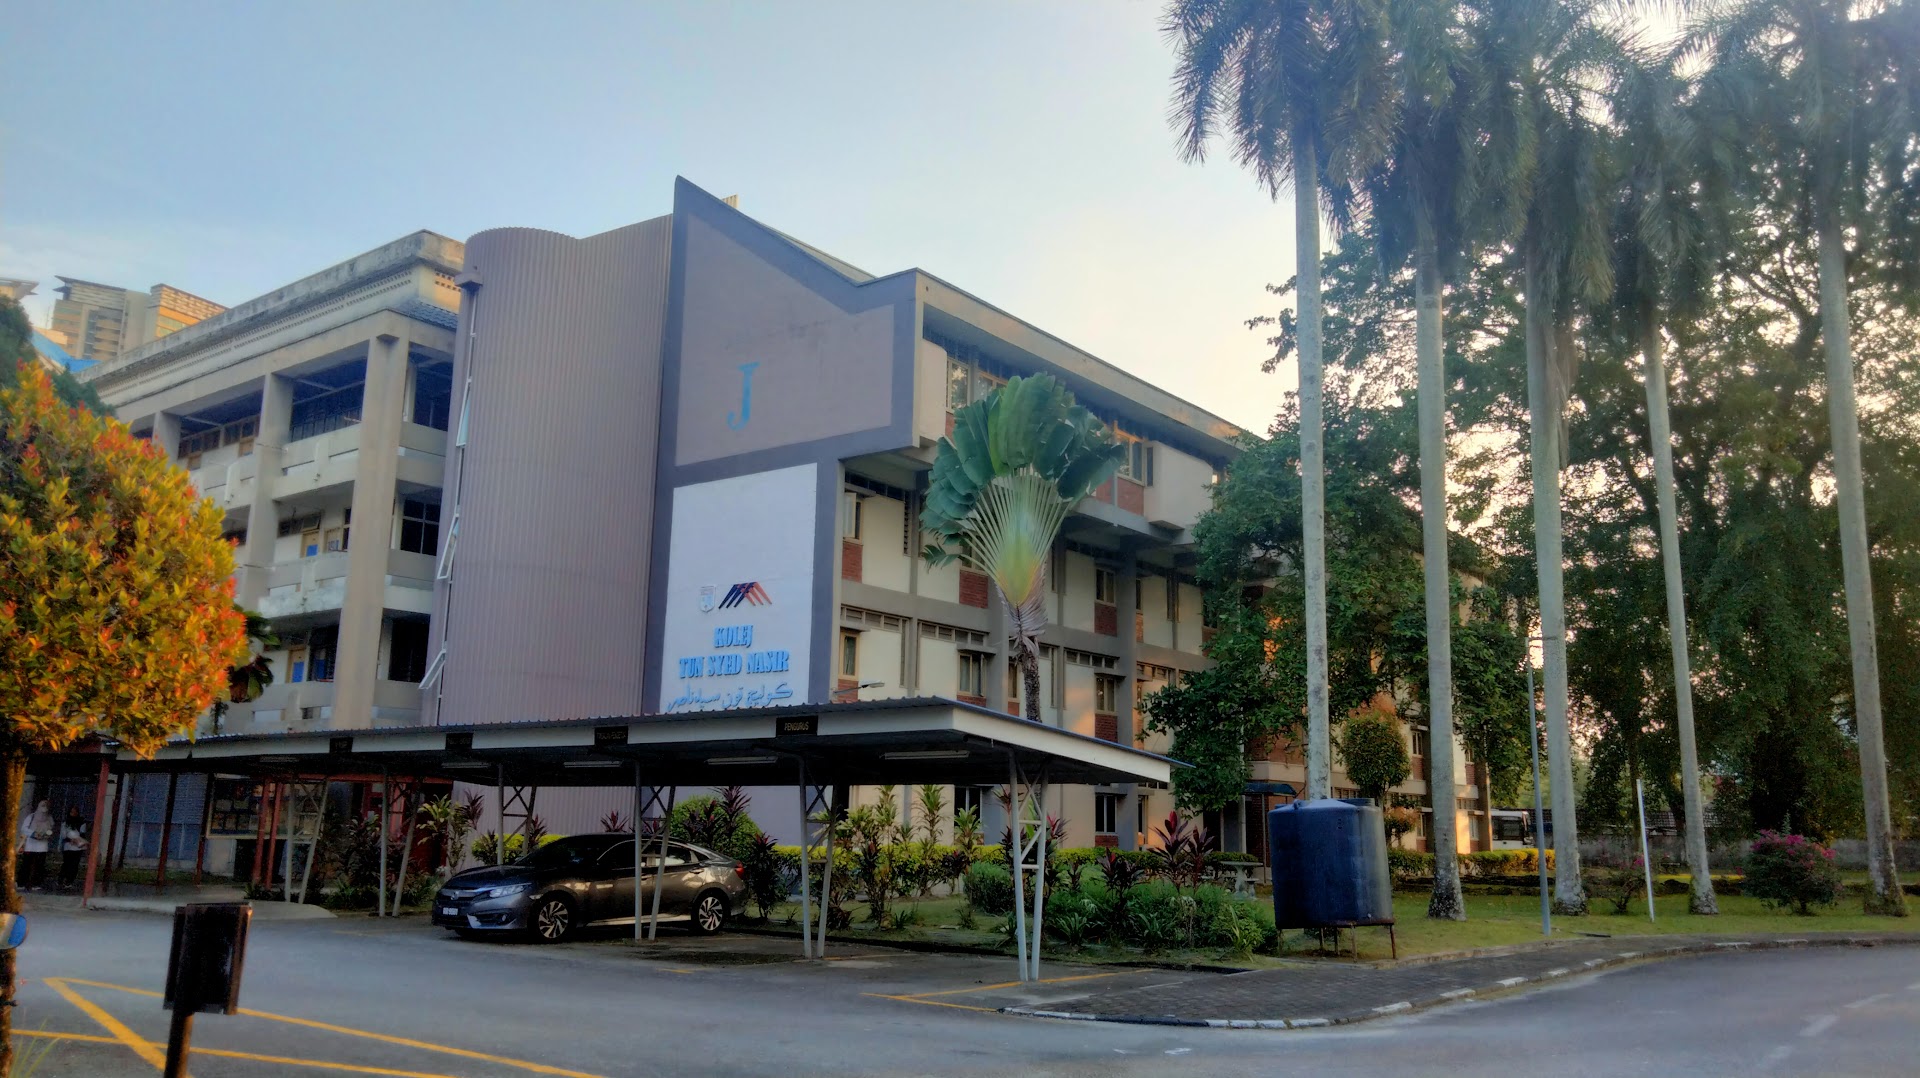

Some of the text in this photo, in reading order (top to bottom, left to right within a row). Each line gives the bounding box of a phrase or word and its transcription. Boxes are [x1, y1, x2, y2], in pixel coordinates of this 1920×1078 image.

[726, 361, 760, 432] J
[714, 625, 753, 648] KOLEJ
[679, 651, 789, 679] TUN SYED NASIR
